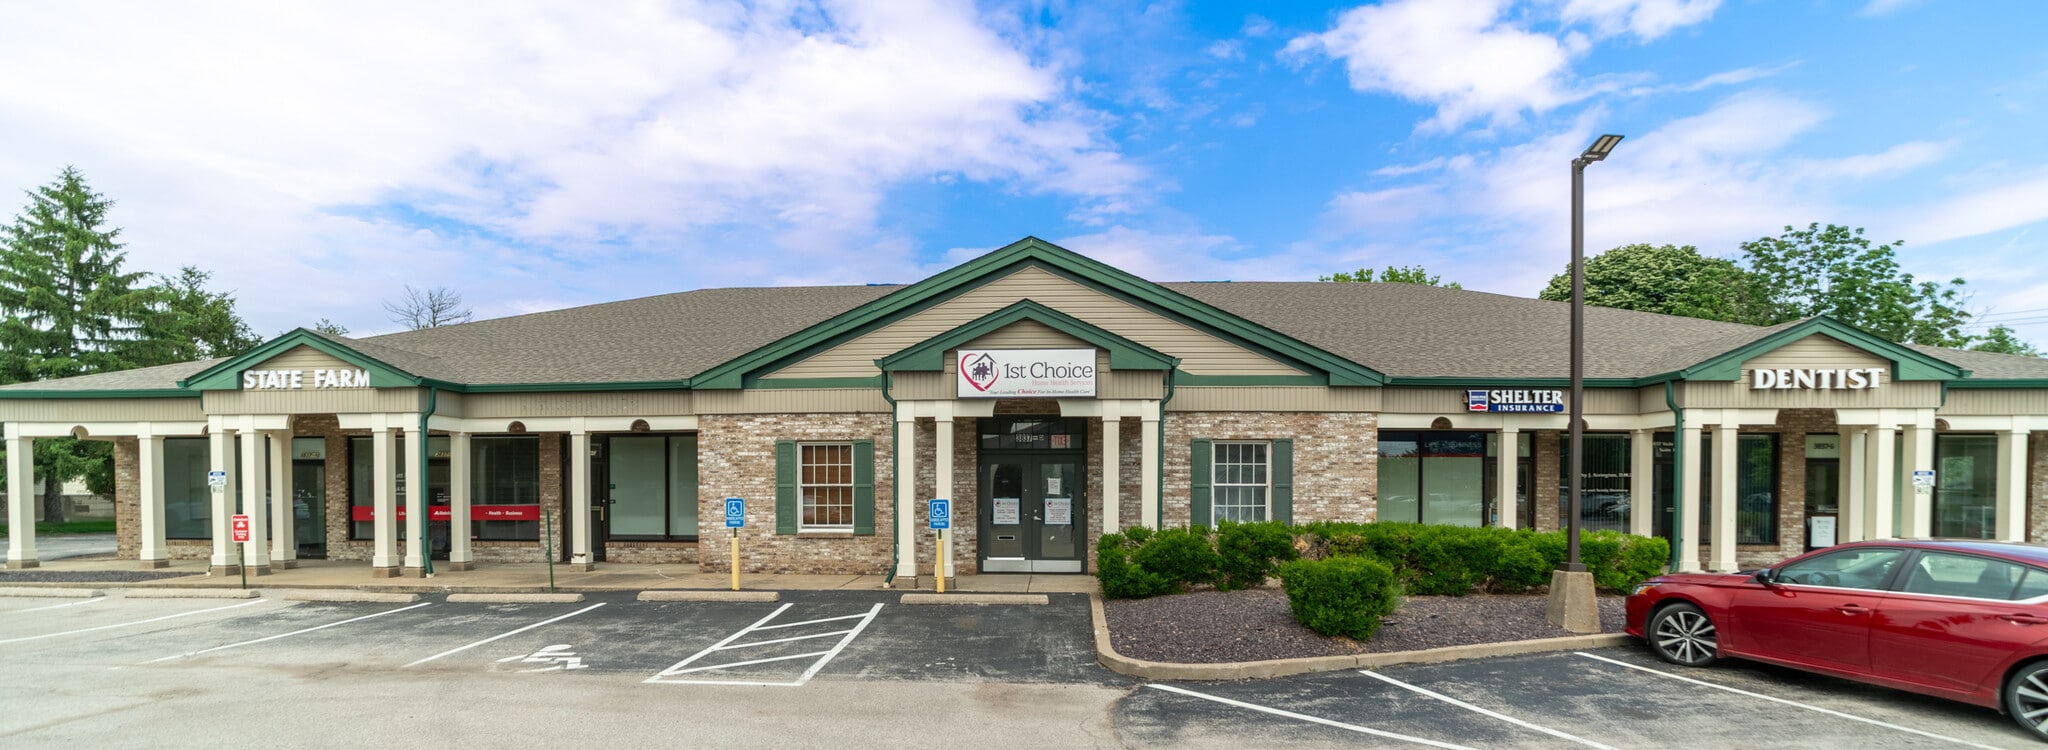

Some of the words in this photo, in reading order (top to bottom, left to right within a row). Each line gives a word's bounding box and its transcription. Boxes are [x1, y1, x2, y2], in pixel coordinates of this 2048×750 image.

[243, 369, 304, 389] STATE
[315, 368, 370, 388] FARM
[1004, 363, 1026, 379] 1st
[1029, 361, 1093, 379] Choice
[1754, 367, 1885, 389] DENTIST
[1491, 389, 1564, 404] SHELTER
